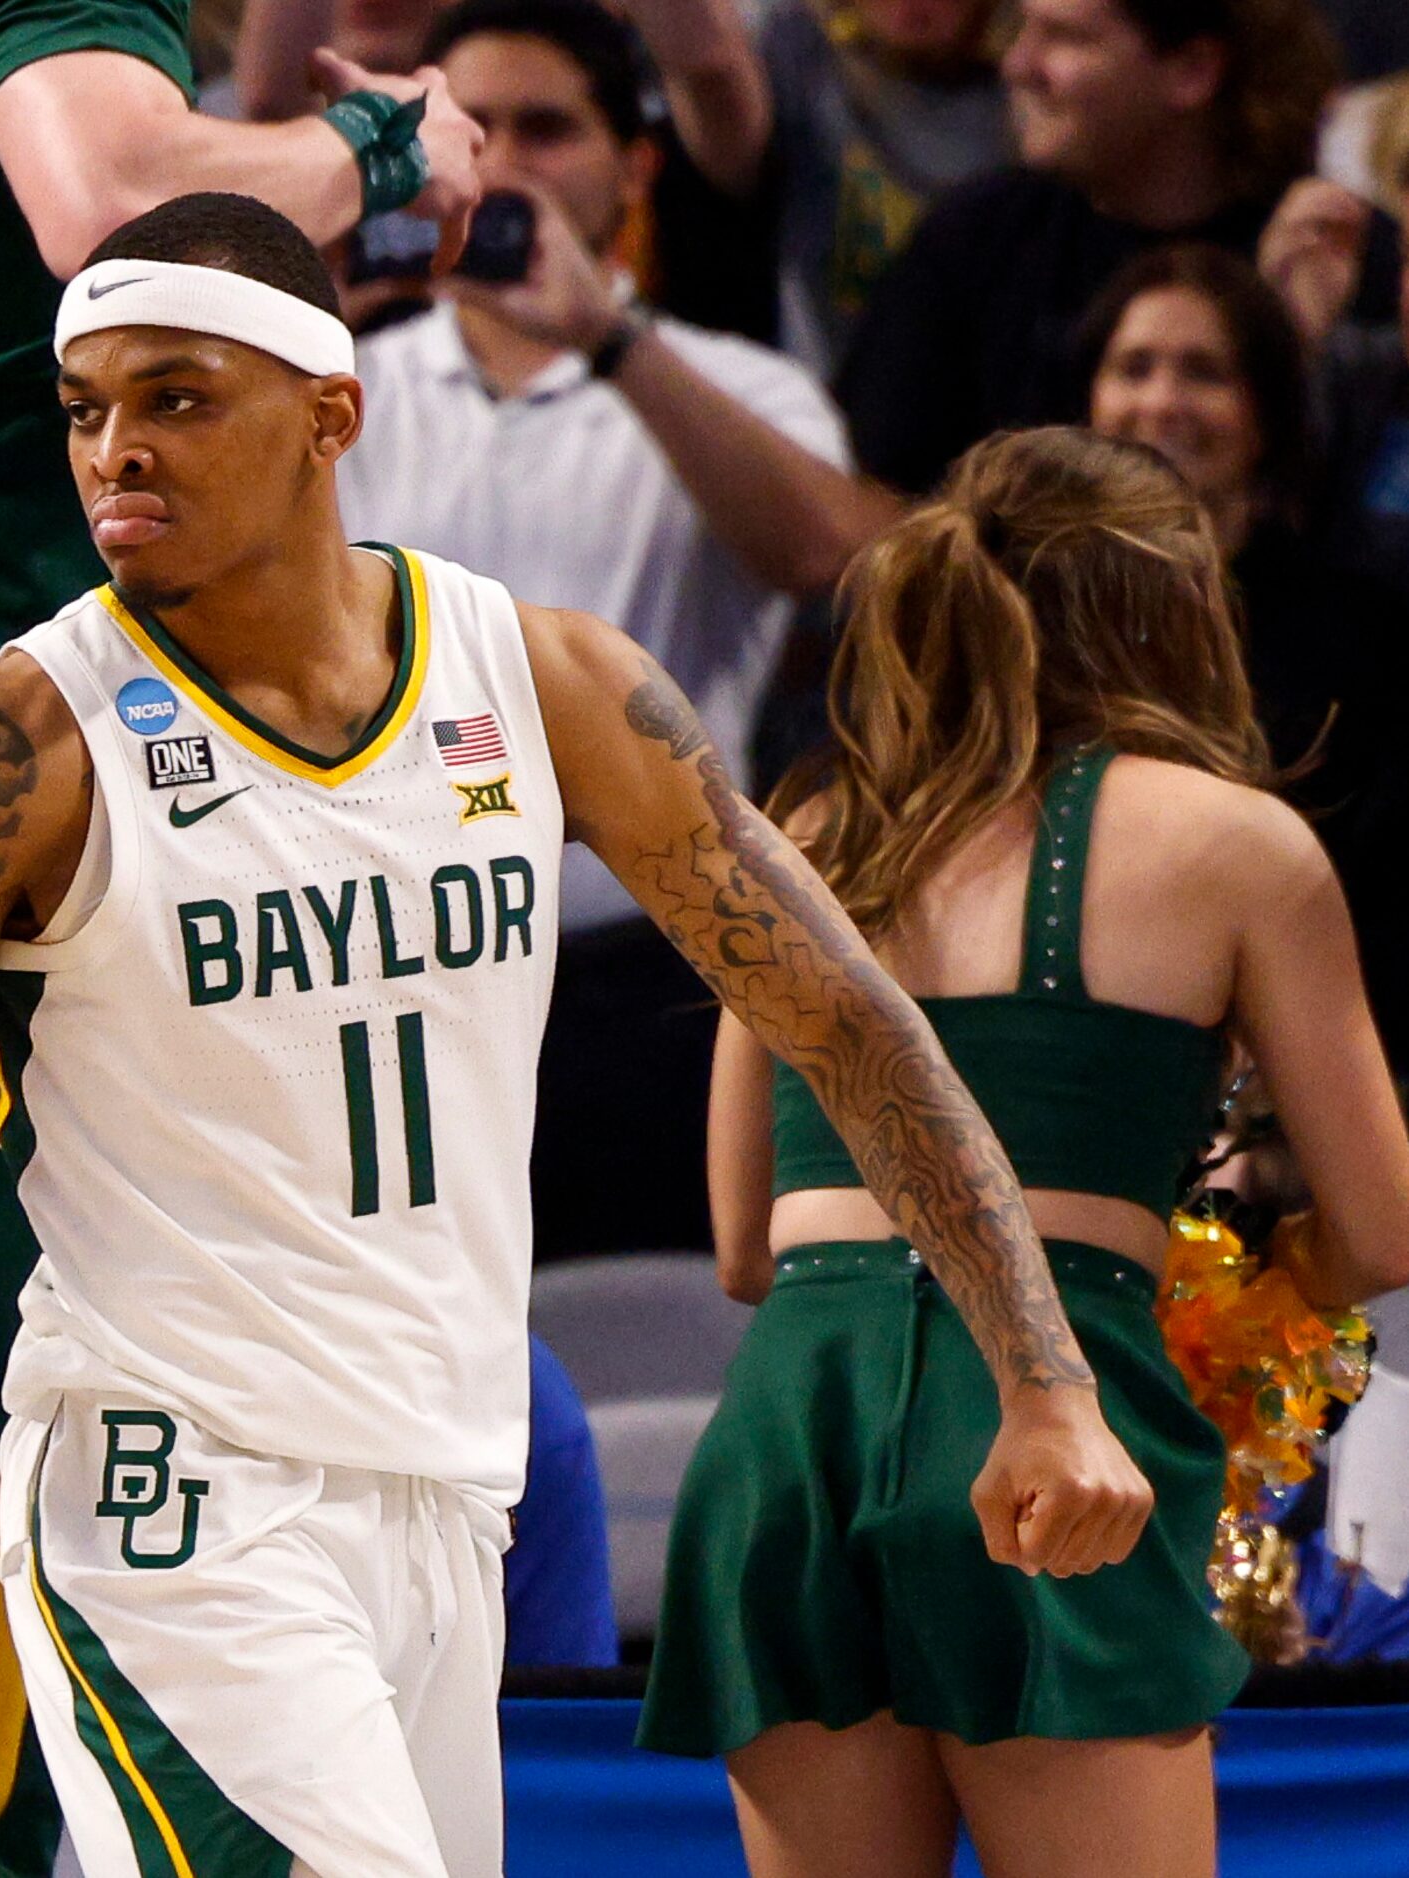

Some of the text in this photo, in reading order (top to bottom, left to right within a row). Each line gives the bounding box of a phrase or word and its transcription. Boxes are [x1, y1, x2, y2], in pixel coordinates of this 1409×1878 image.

[127, 701, 175, 721] NCAA
[152, 739, 209, 776] ONE
[177, 855, 535, 1007] BAYLOR
[339, 1010, 437, 1218] 11
[95, 1409, 210, 1569] BU
